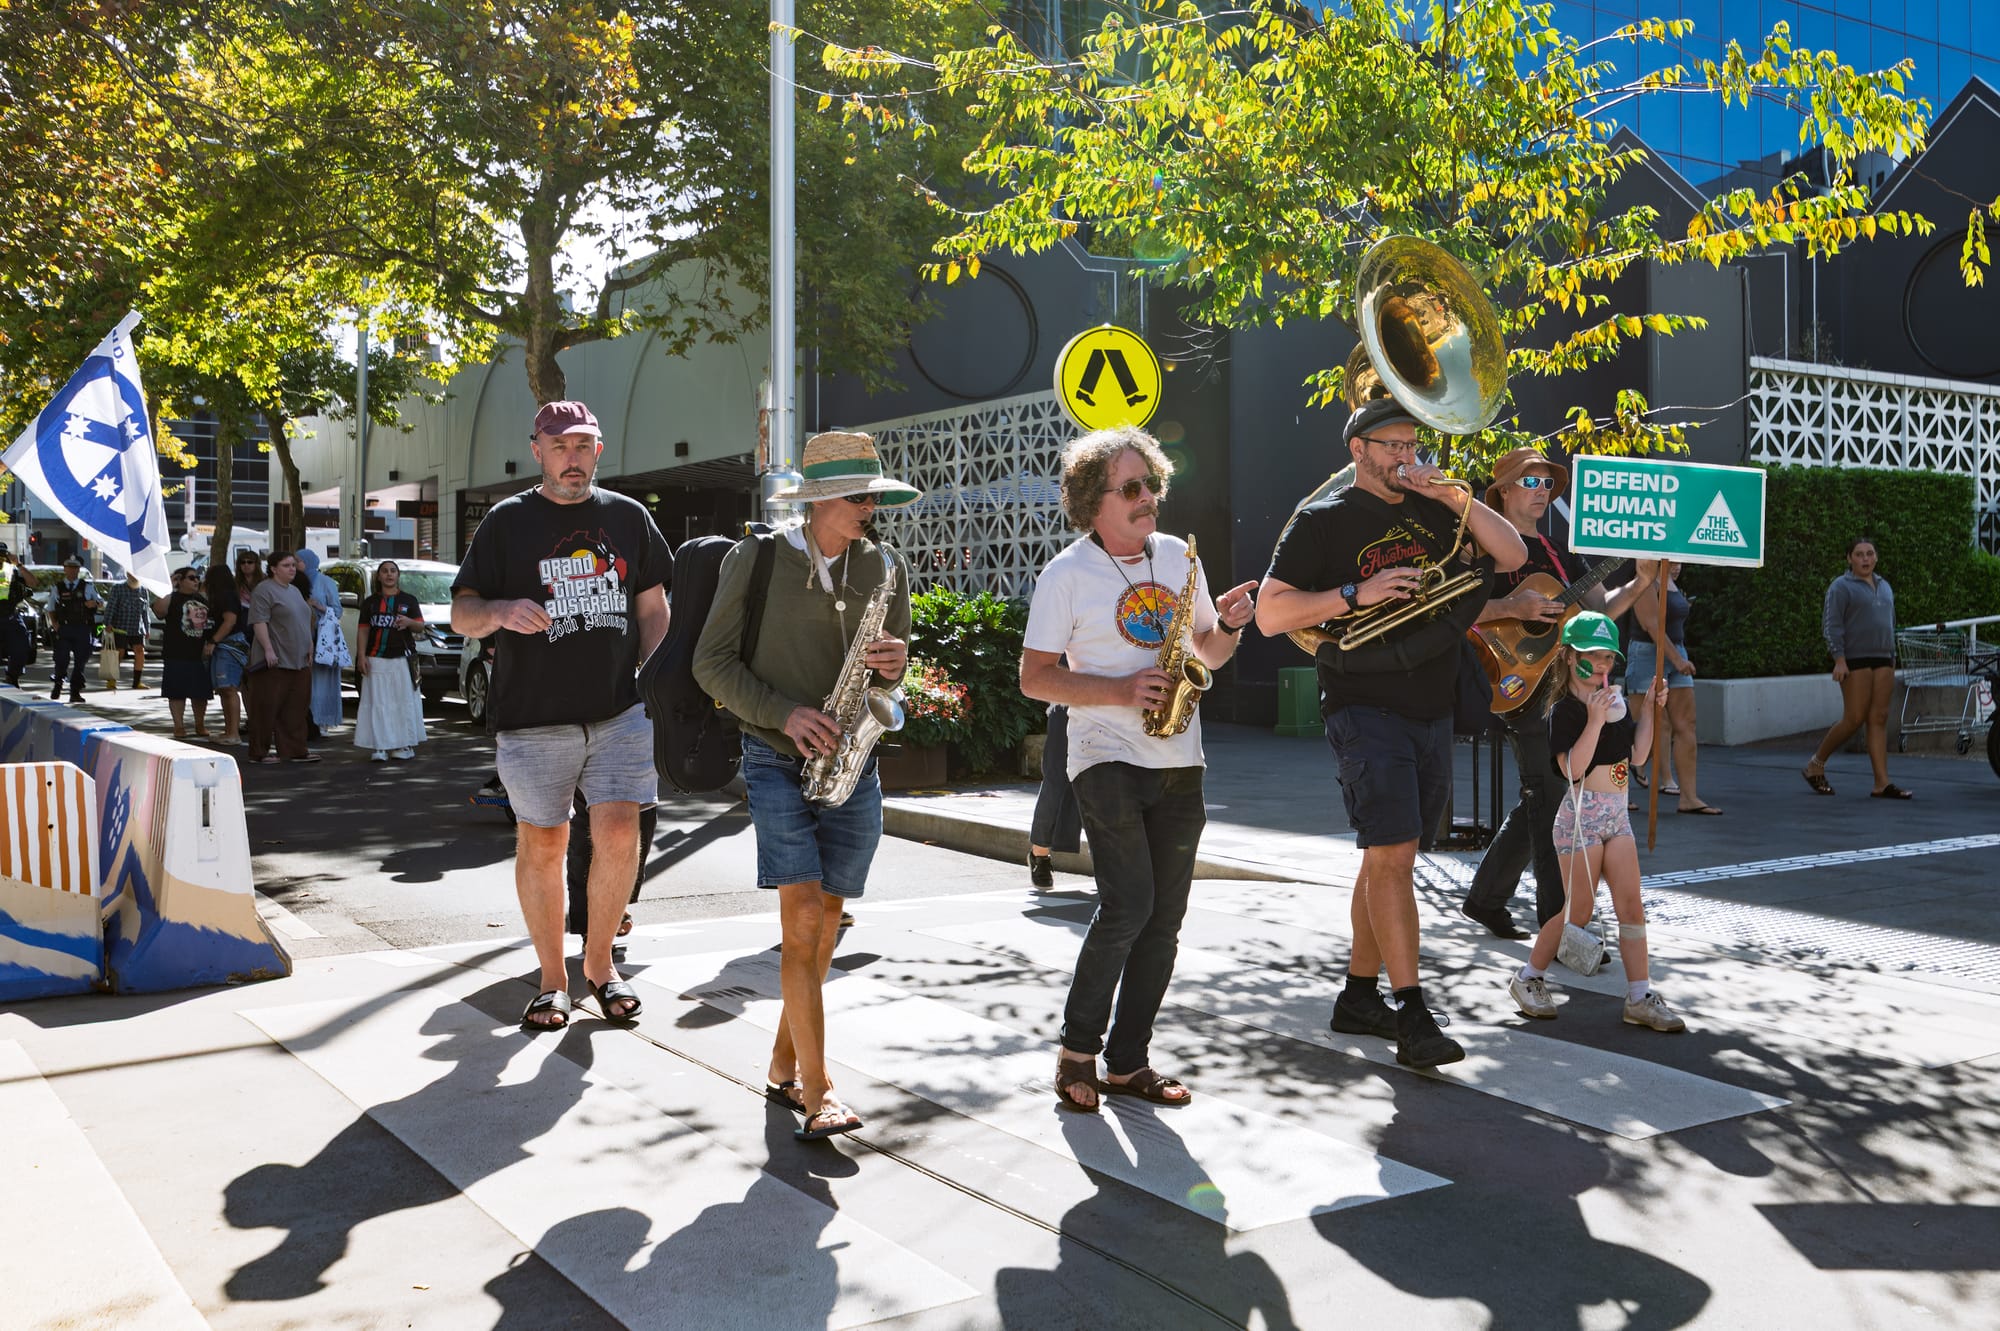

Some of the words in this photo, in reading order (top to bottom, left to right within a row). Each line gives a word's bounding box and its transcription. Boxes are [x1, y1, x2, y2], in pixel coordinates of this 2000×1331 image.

[1583, 469, 1680, 493] DEFEND
[1582, 494, 1676, 518] HUMAN
[1581, 518, 1667, 541] RIGHTS
[1707, 515, 1729, 529] THE
[1696, 528, 1739, 543] GREENS
[553, 577, 608, 599] theft
[545, 591, 628, 618] australia
[546, 615, 579, 643] 26th
